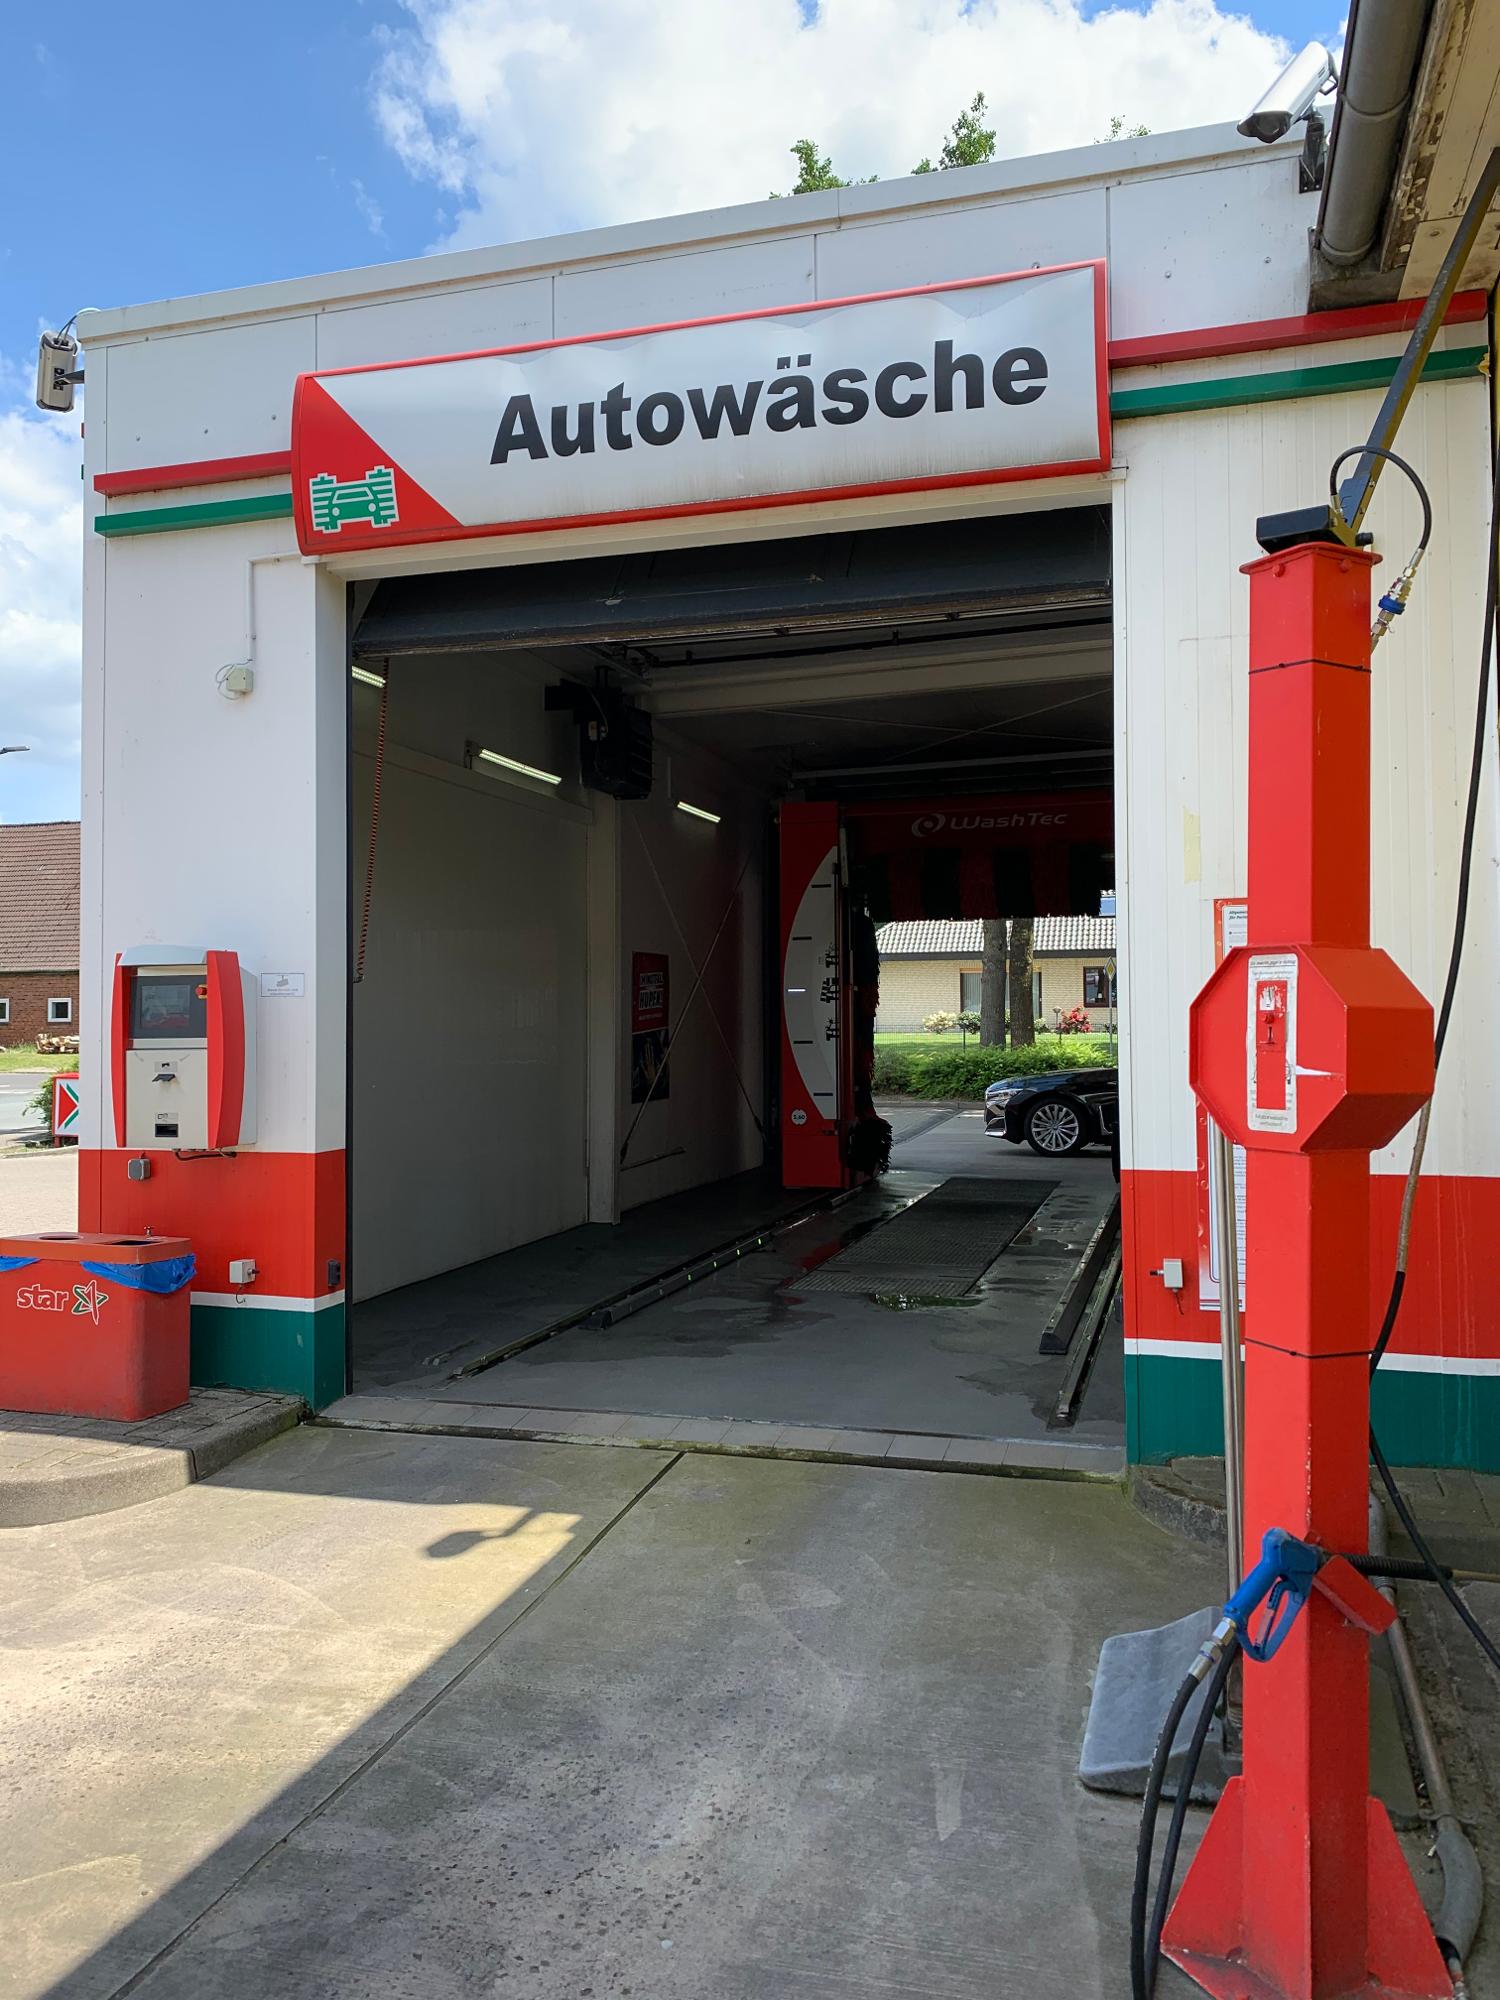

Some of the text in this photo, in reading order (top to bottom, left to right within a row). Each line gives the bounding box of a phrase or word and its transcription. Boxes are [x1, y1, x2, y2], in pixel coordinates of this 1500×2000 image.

[490, 340, 1049, 464] Autowäsche
[950, 812, 1068, 830] WashTec
[17, 1284, 69, 1312] star
